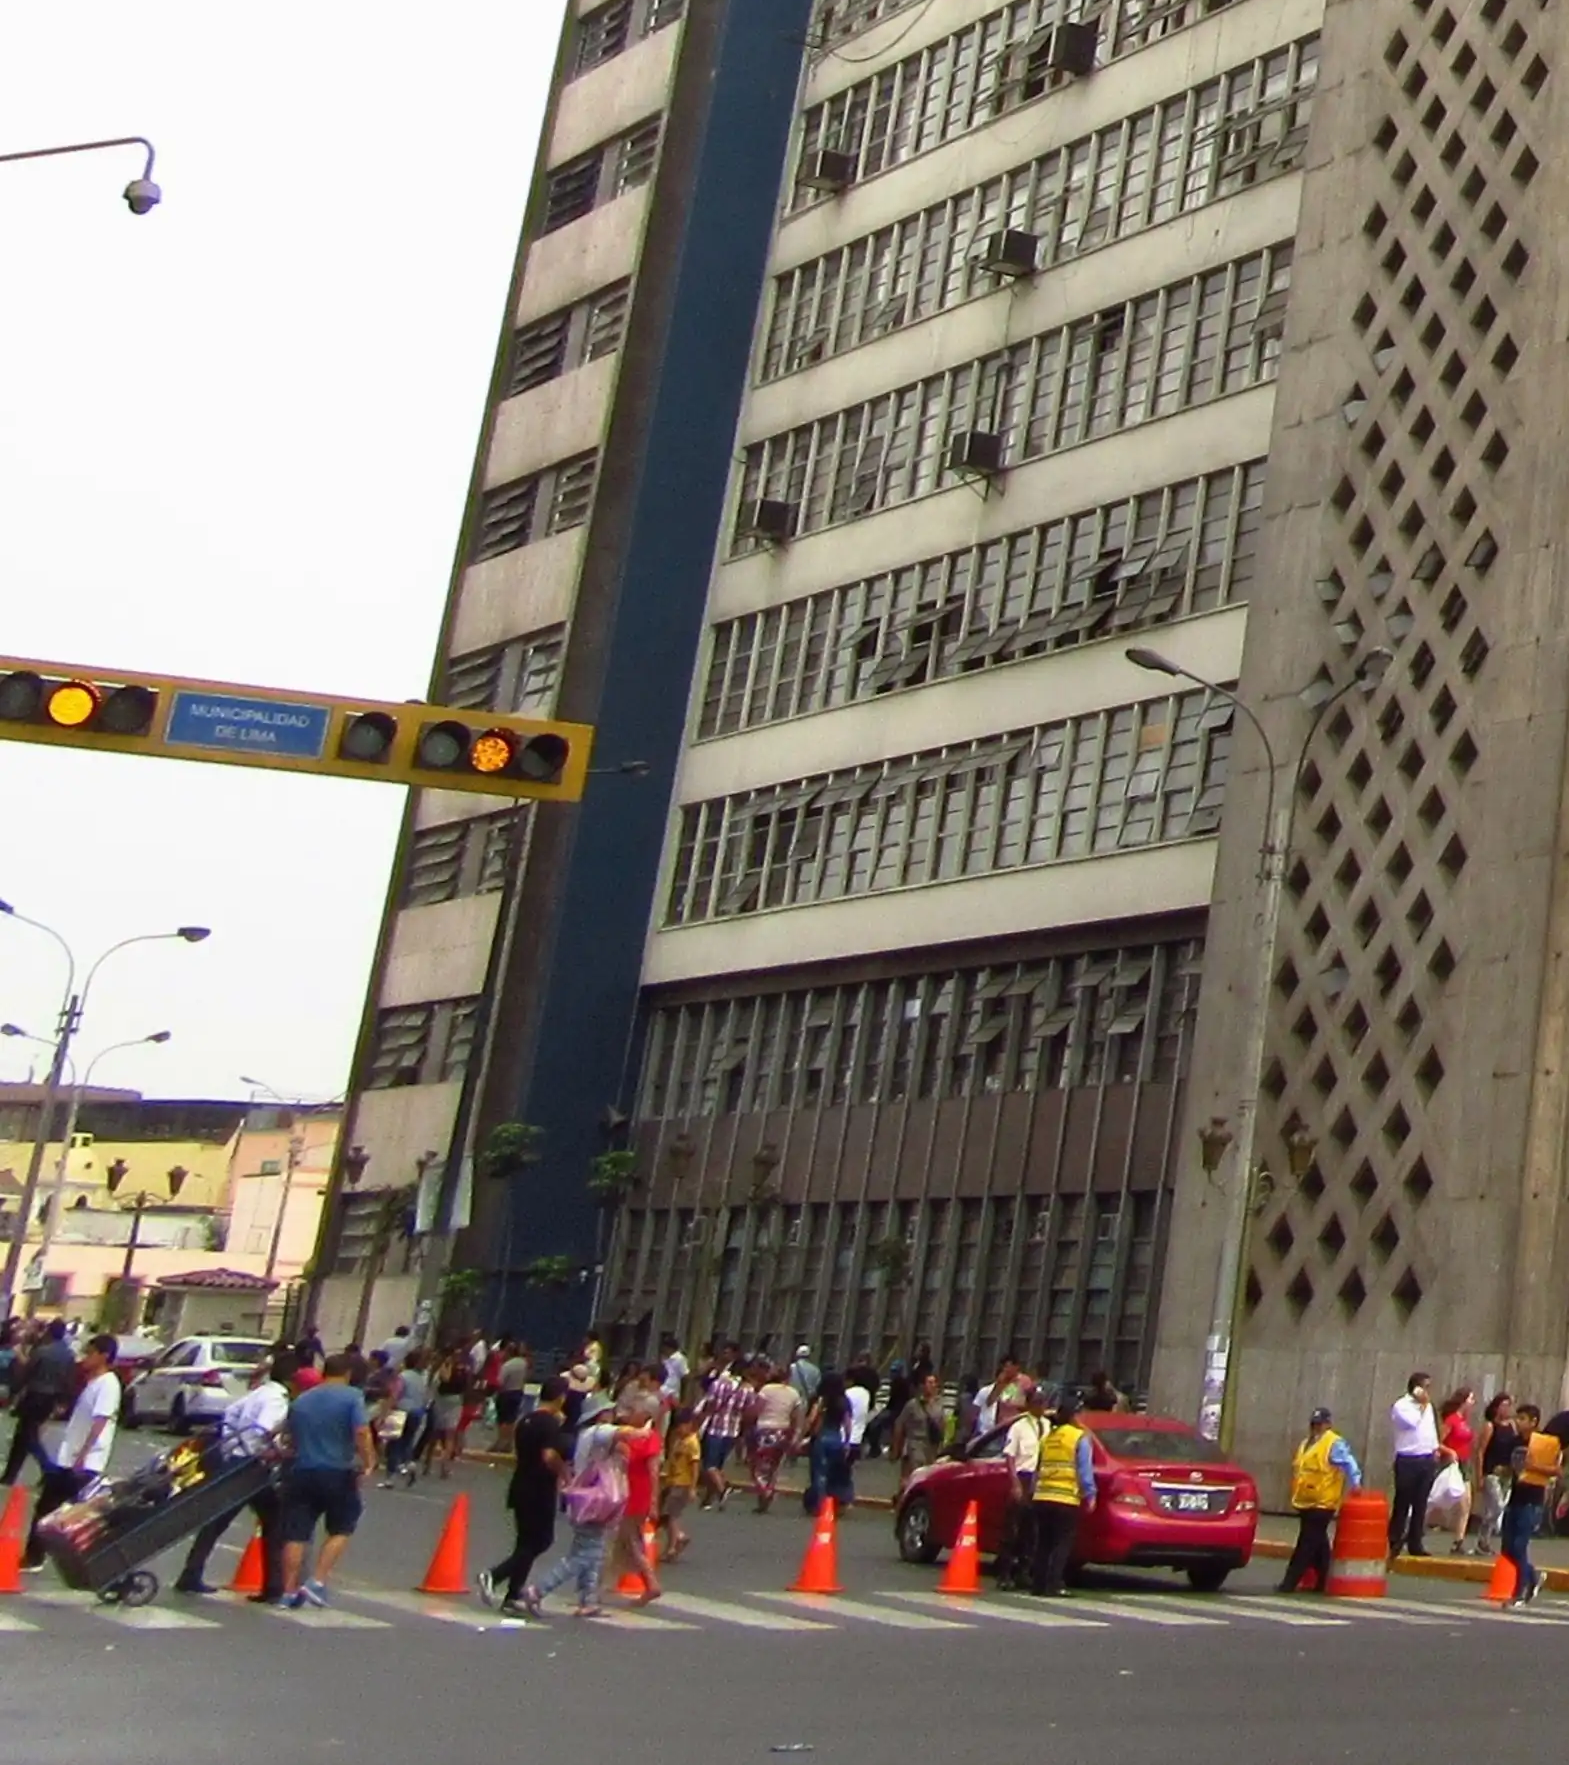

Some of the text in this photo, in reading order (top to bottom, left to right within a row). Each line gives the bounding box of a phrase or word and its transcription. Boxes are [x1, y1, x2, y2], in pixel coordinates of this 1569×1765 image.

[190, 703, 310, 728] MUNICIPALIDAD
[215, 725, 276, 742] DE LIMA
